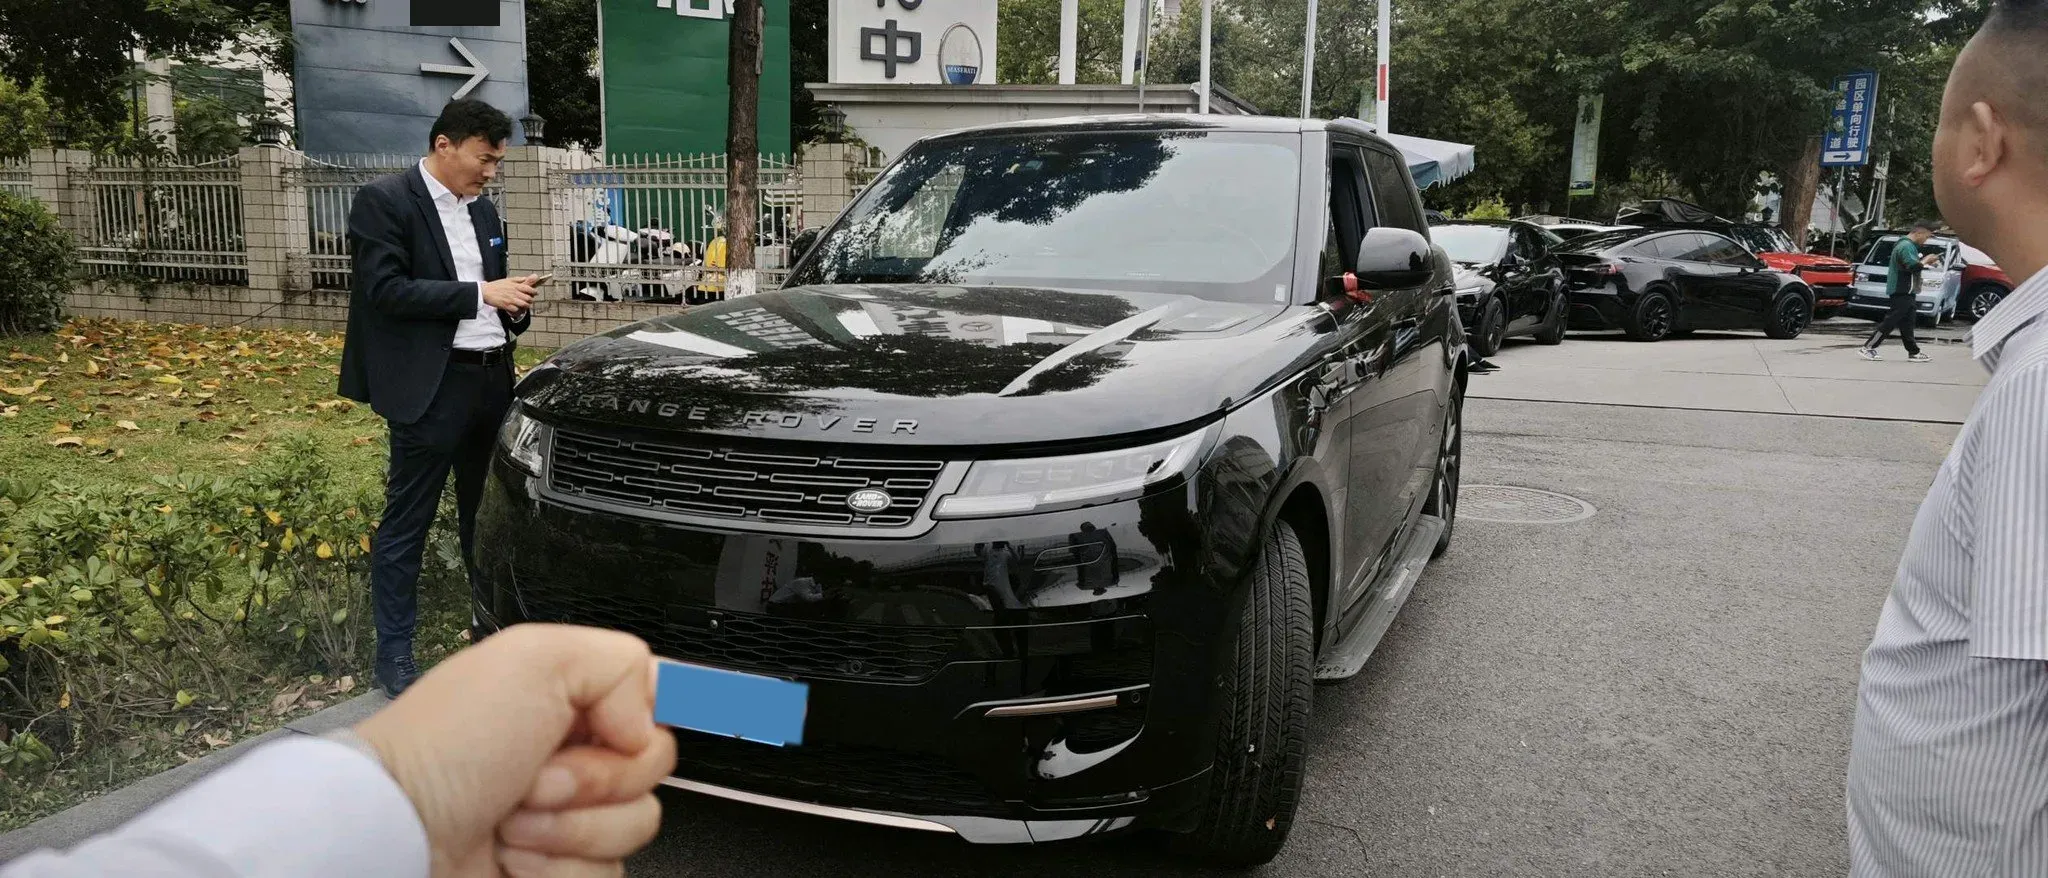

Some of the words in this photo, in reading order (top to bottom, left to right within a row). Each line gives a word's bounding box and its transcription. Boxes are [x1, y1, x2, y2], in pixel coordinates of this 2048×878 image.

[860, 0, 922, 78] 中
[1847, 78, 1867, 148] 园区单向行驶
[576, 394, 710, 421] RANGE
[742, 411, 920, 435] ROVER
